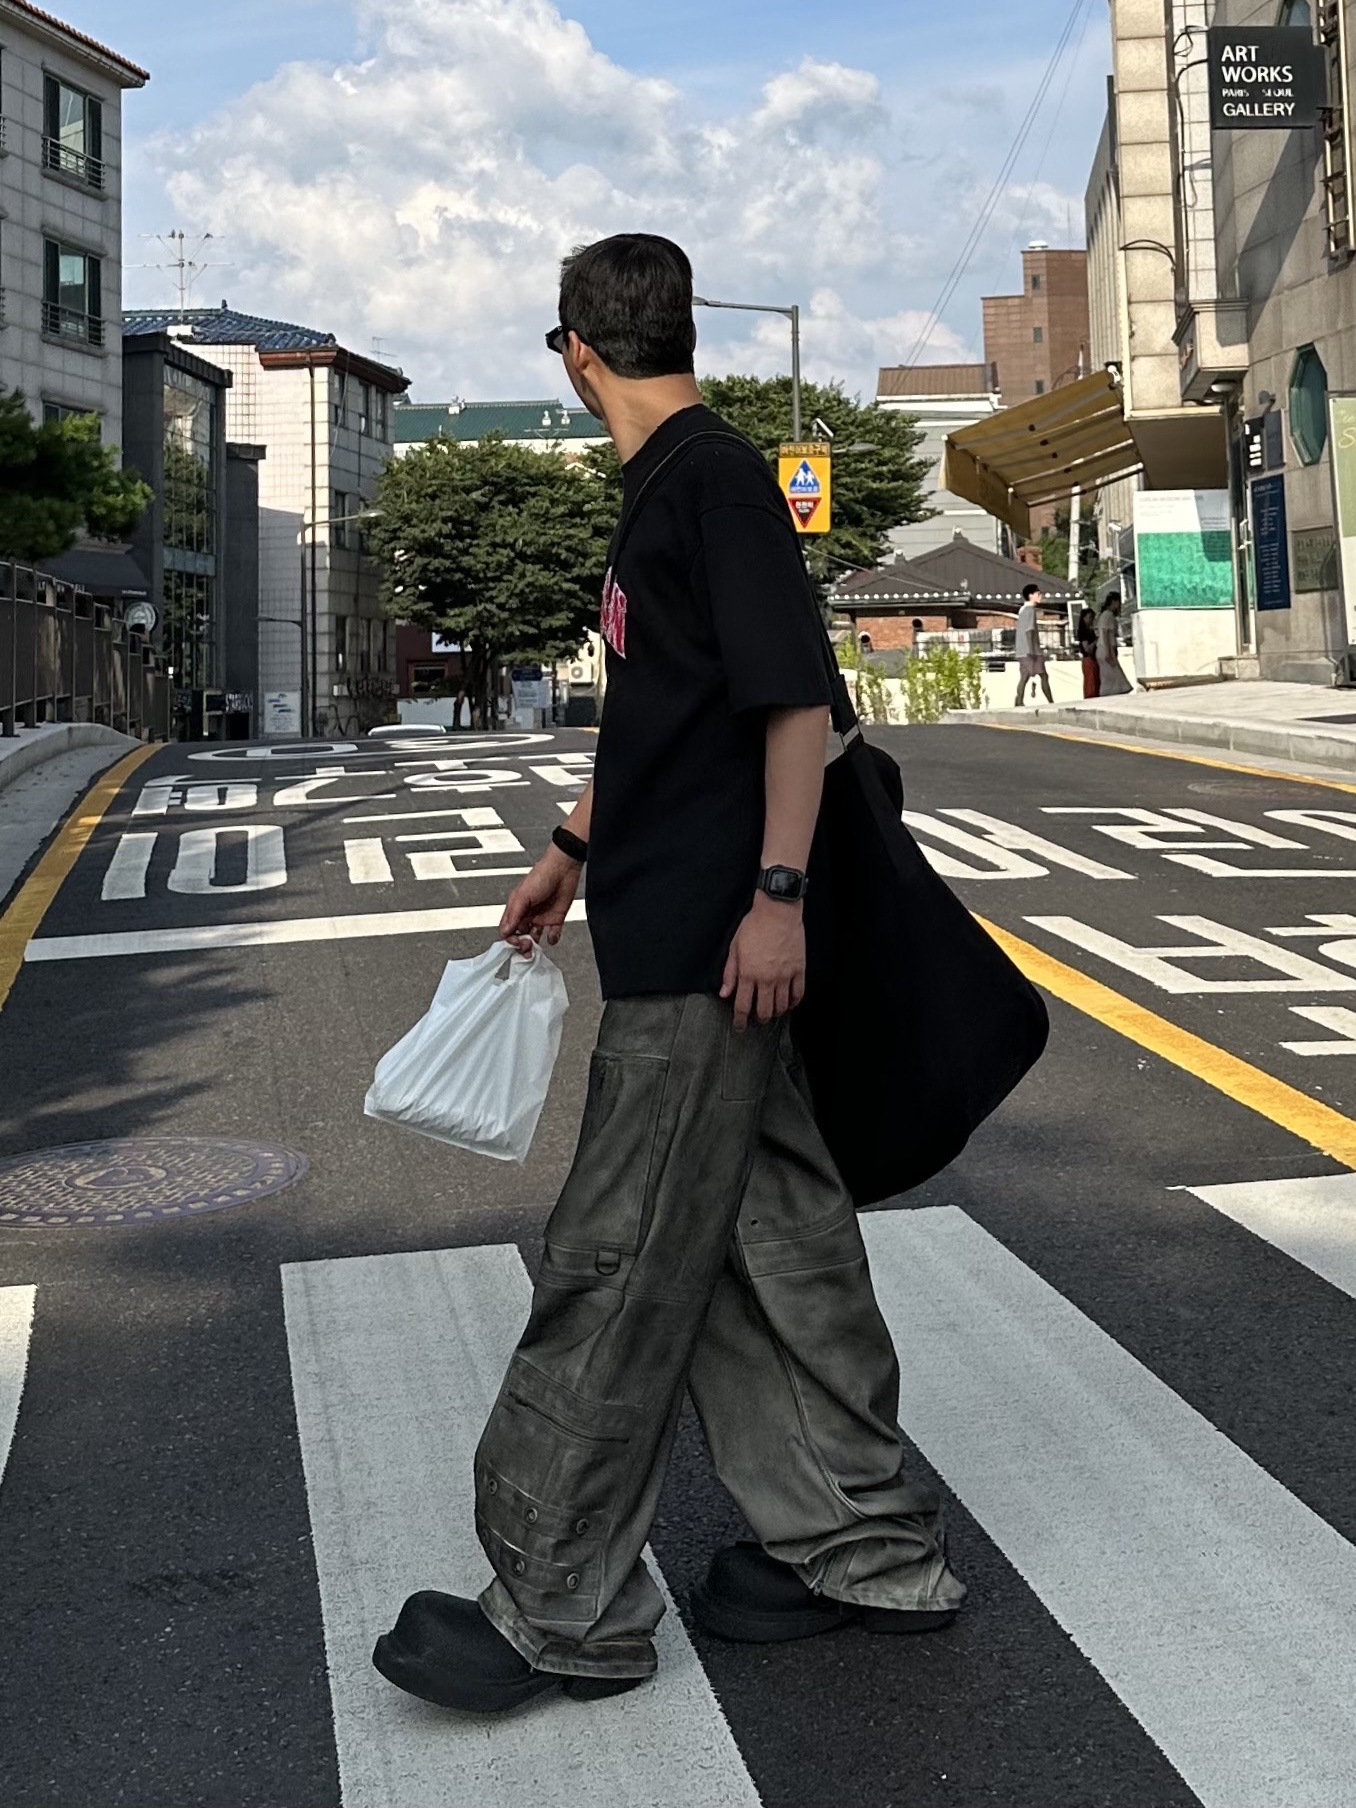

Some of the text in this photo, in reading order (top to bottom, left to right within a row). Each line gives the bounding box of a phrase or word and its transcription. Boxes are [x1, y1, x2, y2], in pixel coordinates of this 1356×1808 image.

[1221, 45, 1259, 62] ART
[1221, 65, 1293, 83] WORKS
[1222, 102, 1295, 116] GALLERY
